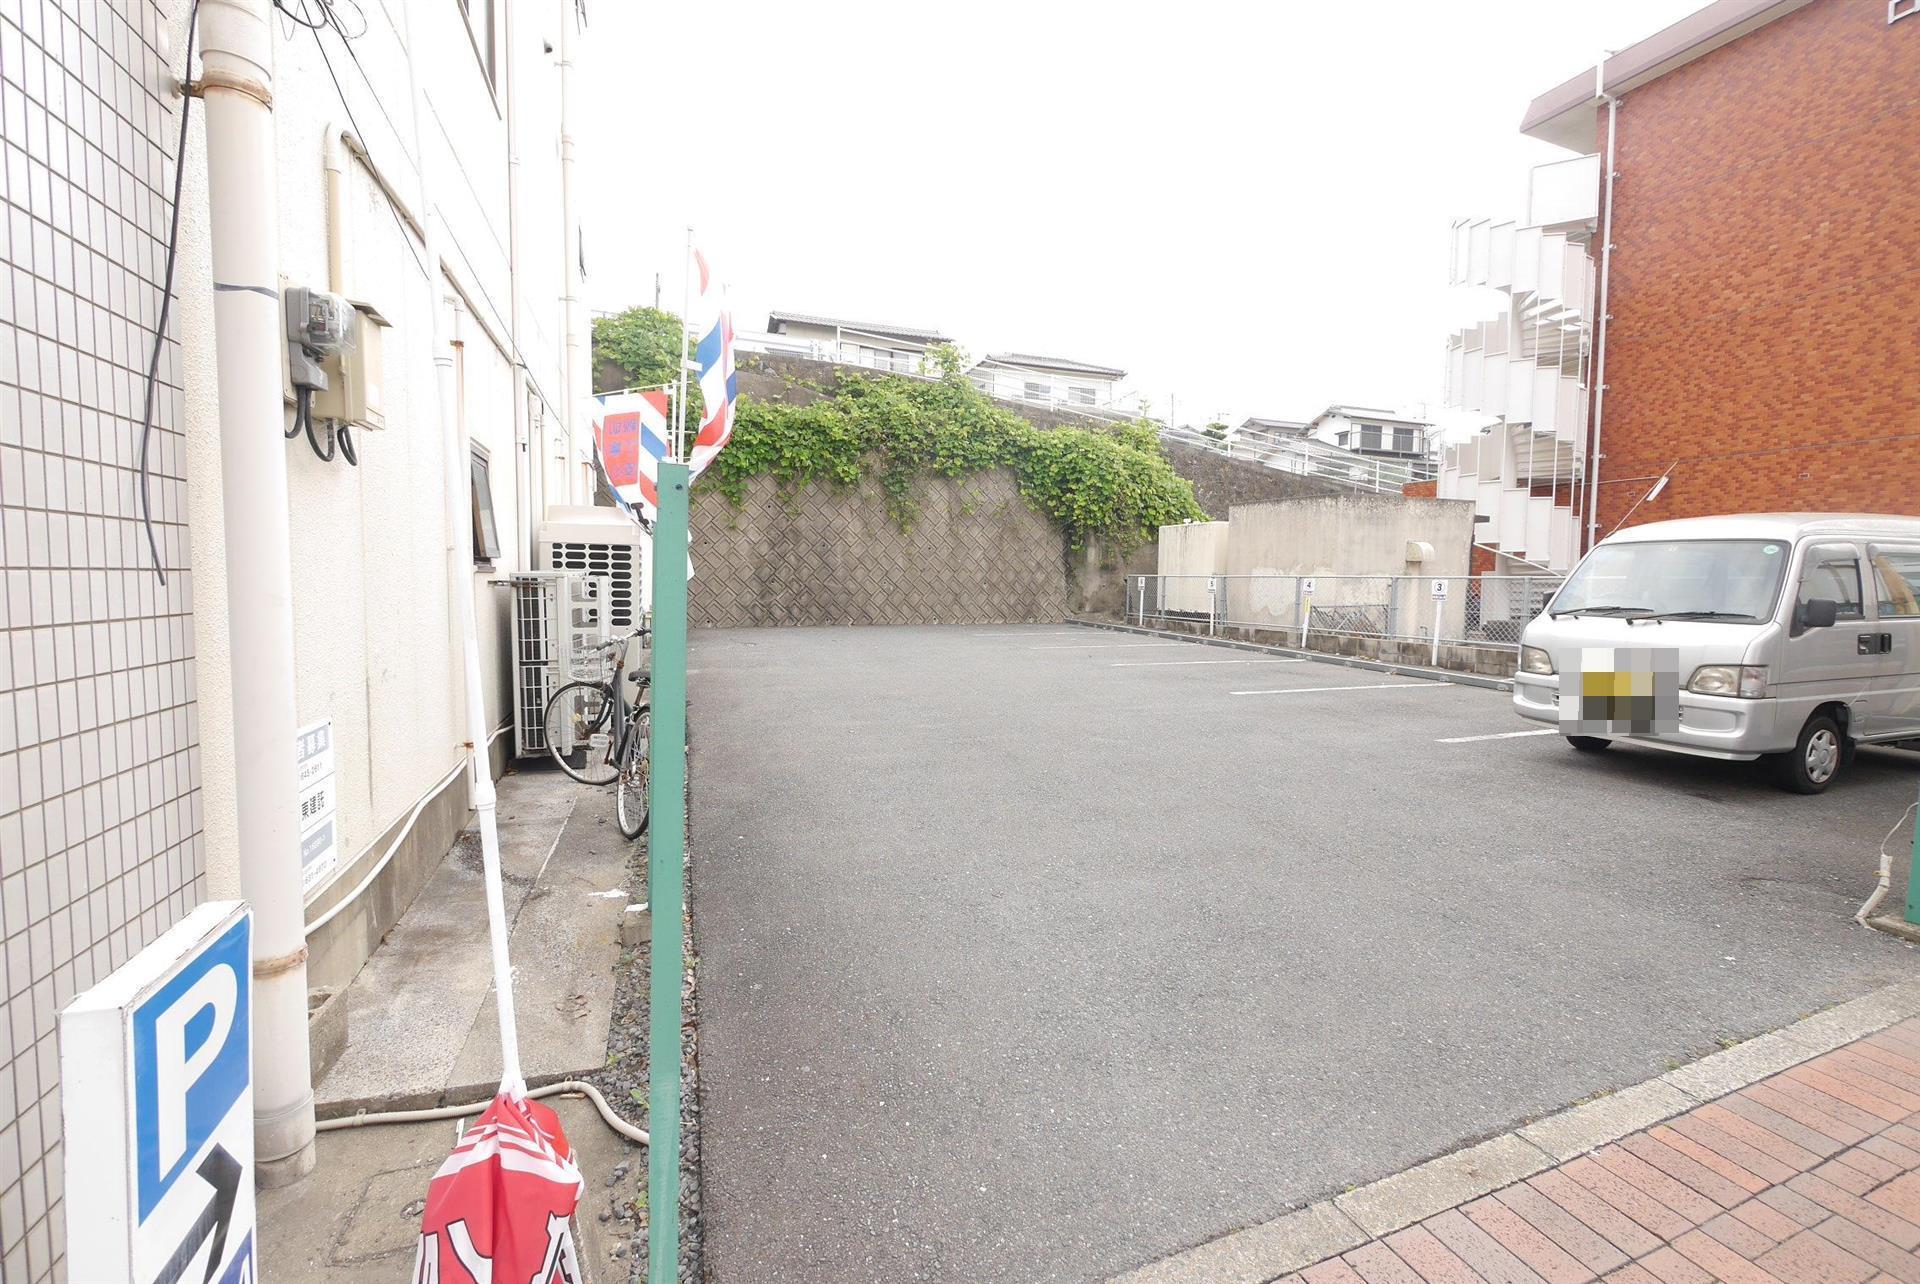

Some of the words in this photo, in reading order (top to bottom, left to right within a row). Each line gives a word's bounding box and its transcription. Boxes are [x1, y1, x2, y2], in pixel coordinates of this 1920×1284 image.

[302, 790, 325, 821] 東建託
[155, 963, 238, 1183] P
